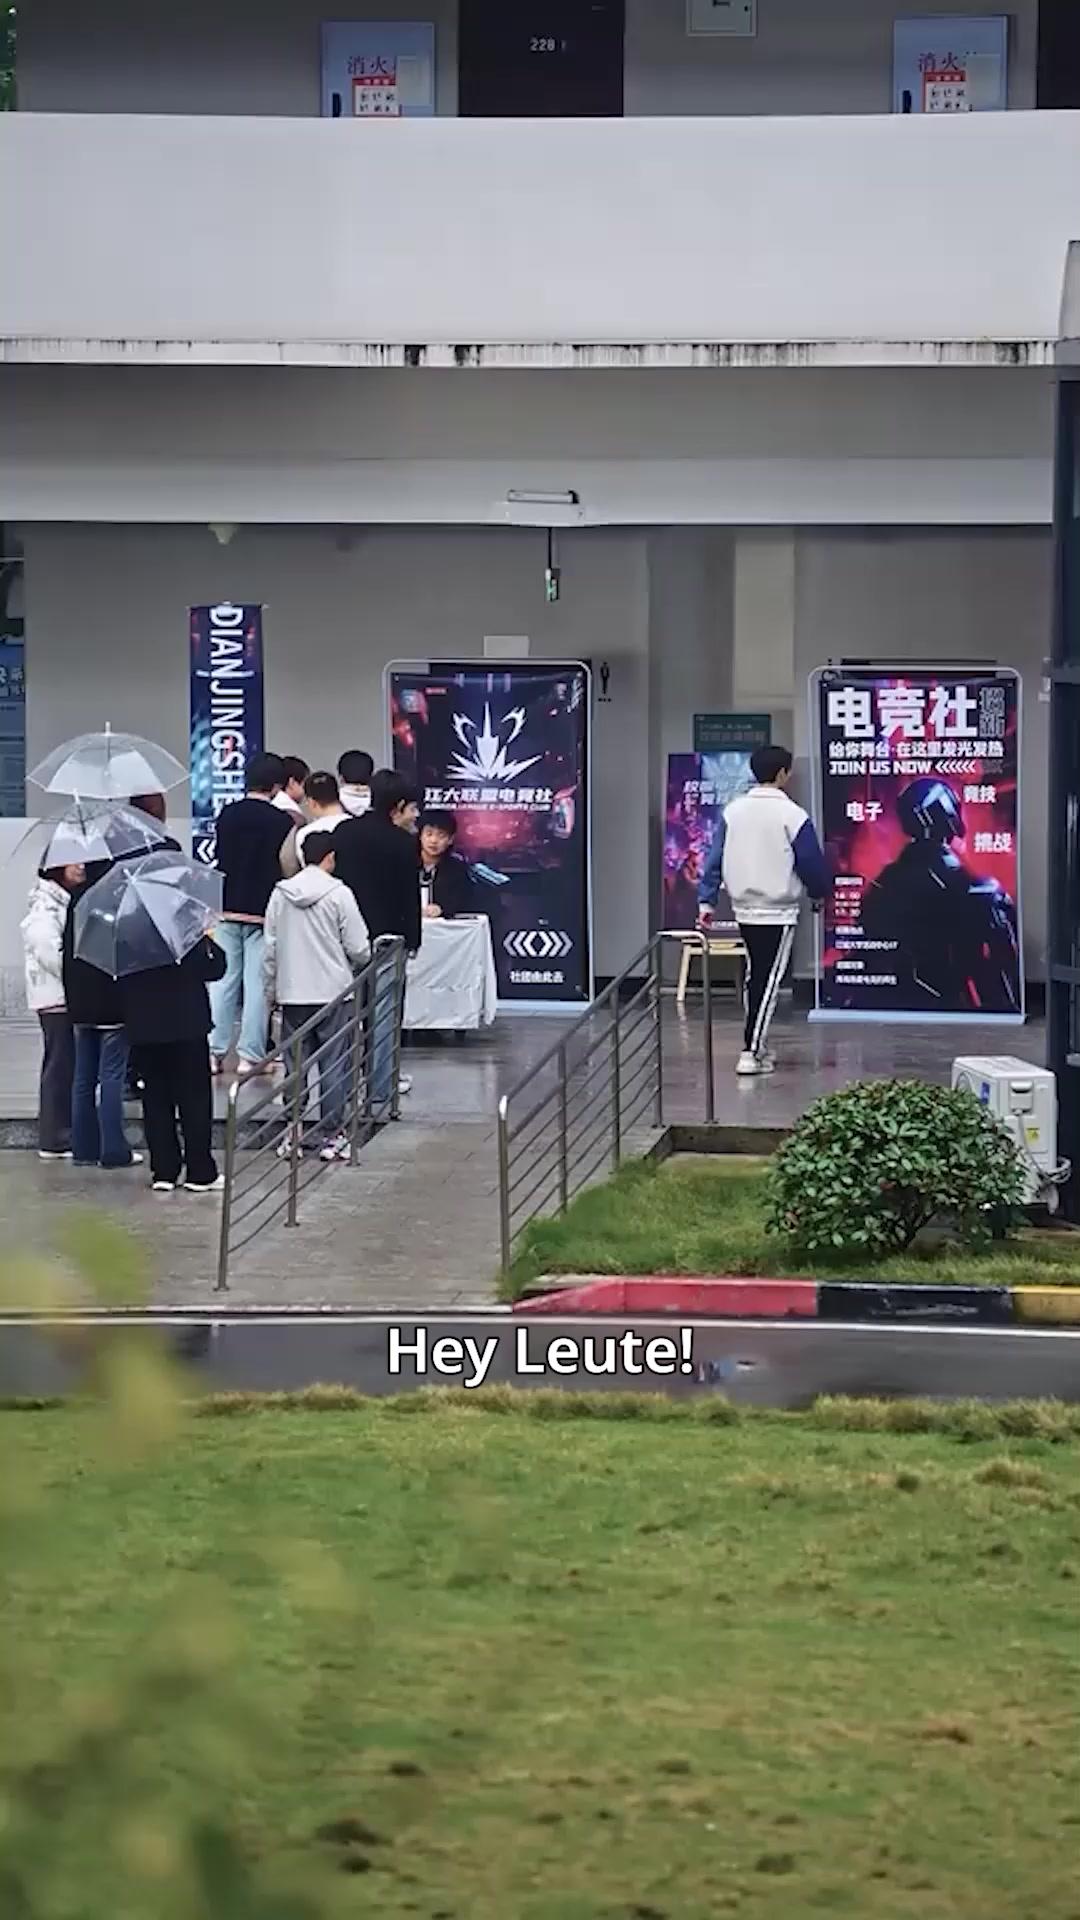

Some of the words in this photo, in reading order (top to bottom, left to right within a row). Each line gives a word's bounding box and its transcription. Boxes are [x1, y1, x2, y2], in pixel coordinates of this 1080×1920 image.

[347, 55, 398, 76] 消火
[827, 686, 978, 738] 电竞社
[829, 760, 867, 776] JOIN
[868, 760, 891, 776] US
[893, 760, 933, 776] NOW
[963, 785, 997, 804] 竞技
[846, 801, 883, 822] 电子
